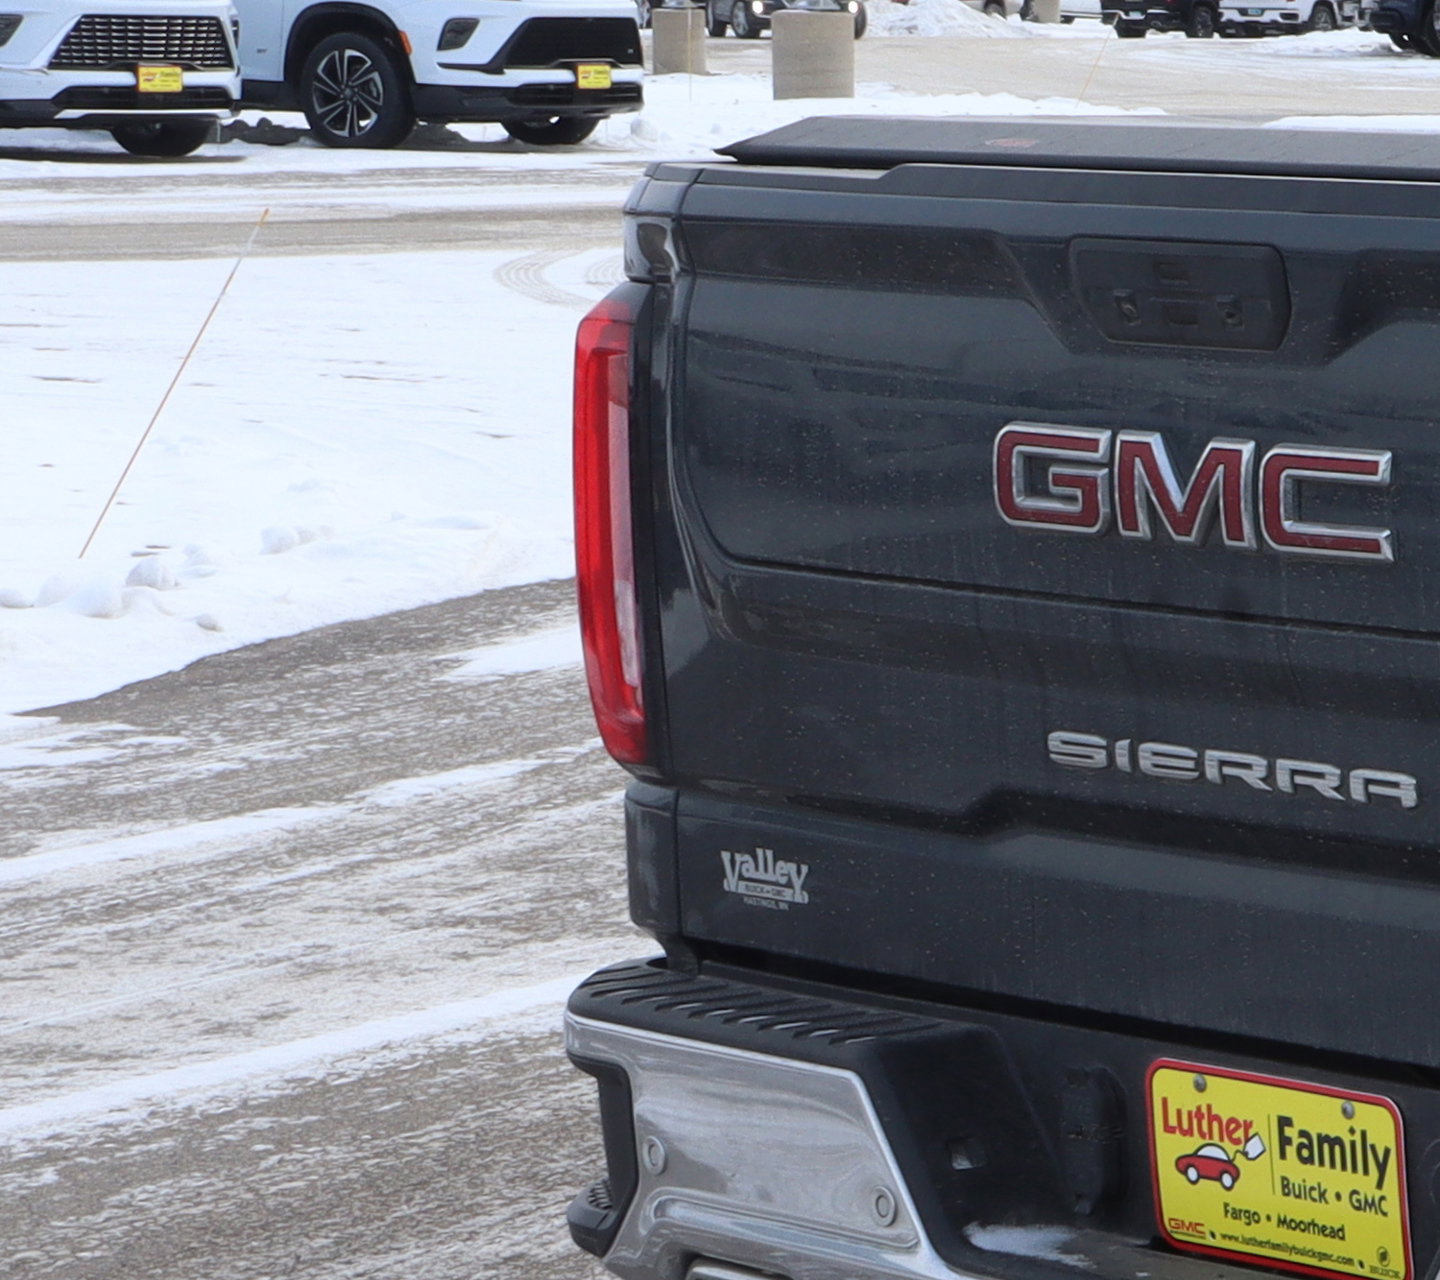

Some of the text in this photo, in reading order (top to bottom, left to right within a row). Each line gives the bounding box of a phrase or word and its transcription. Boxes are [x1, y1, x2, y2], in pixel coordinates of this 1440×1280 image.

[993, 420, 1395, 563] GMC
[1047, 730, 1418, 809] SIERRA
[1161, 1096, 1392, 1191] Luther Family
[1168, 1218, 1206, 1235] GMC
[1223, 1202, 1346, 1241] Fargo Moorhead
[1280, 1176, 1389, 1217] Buick GMC
